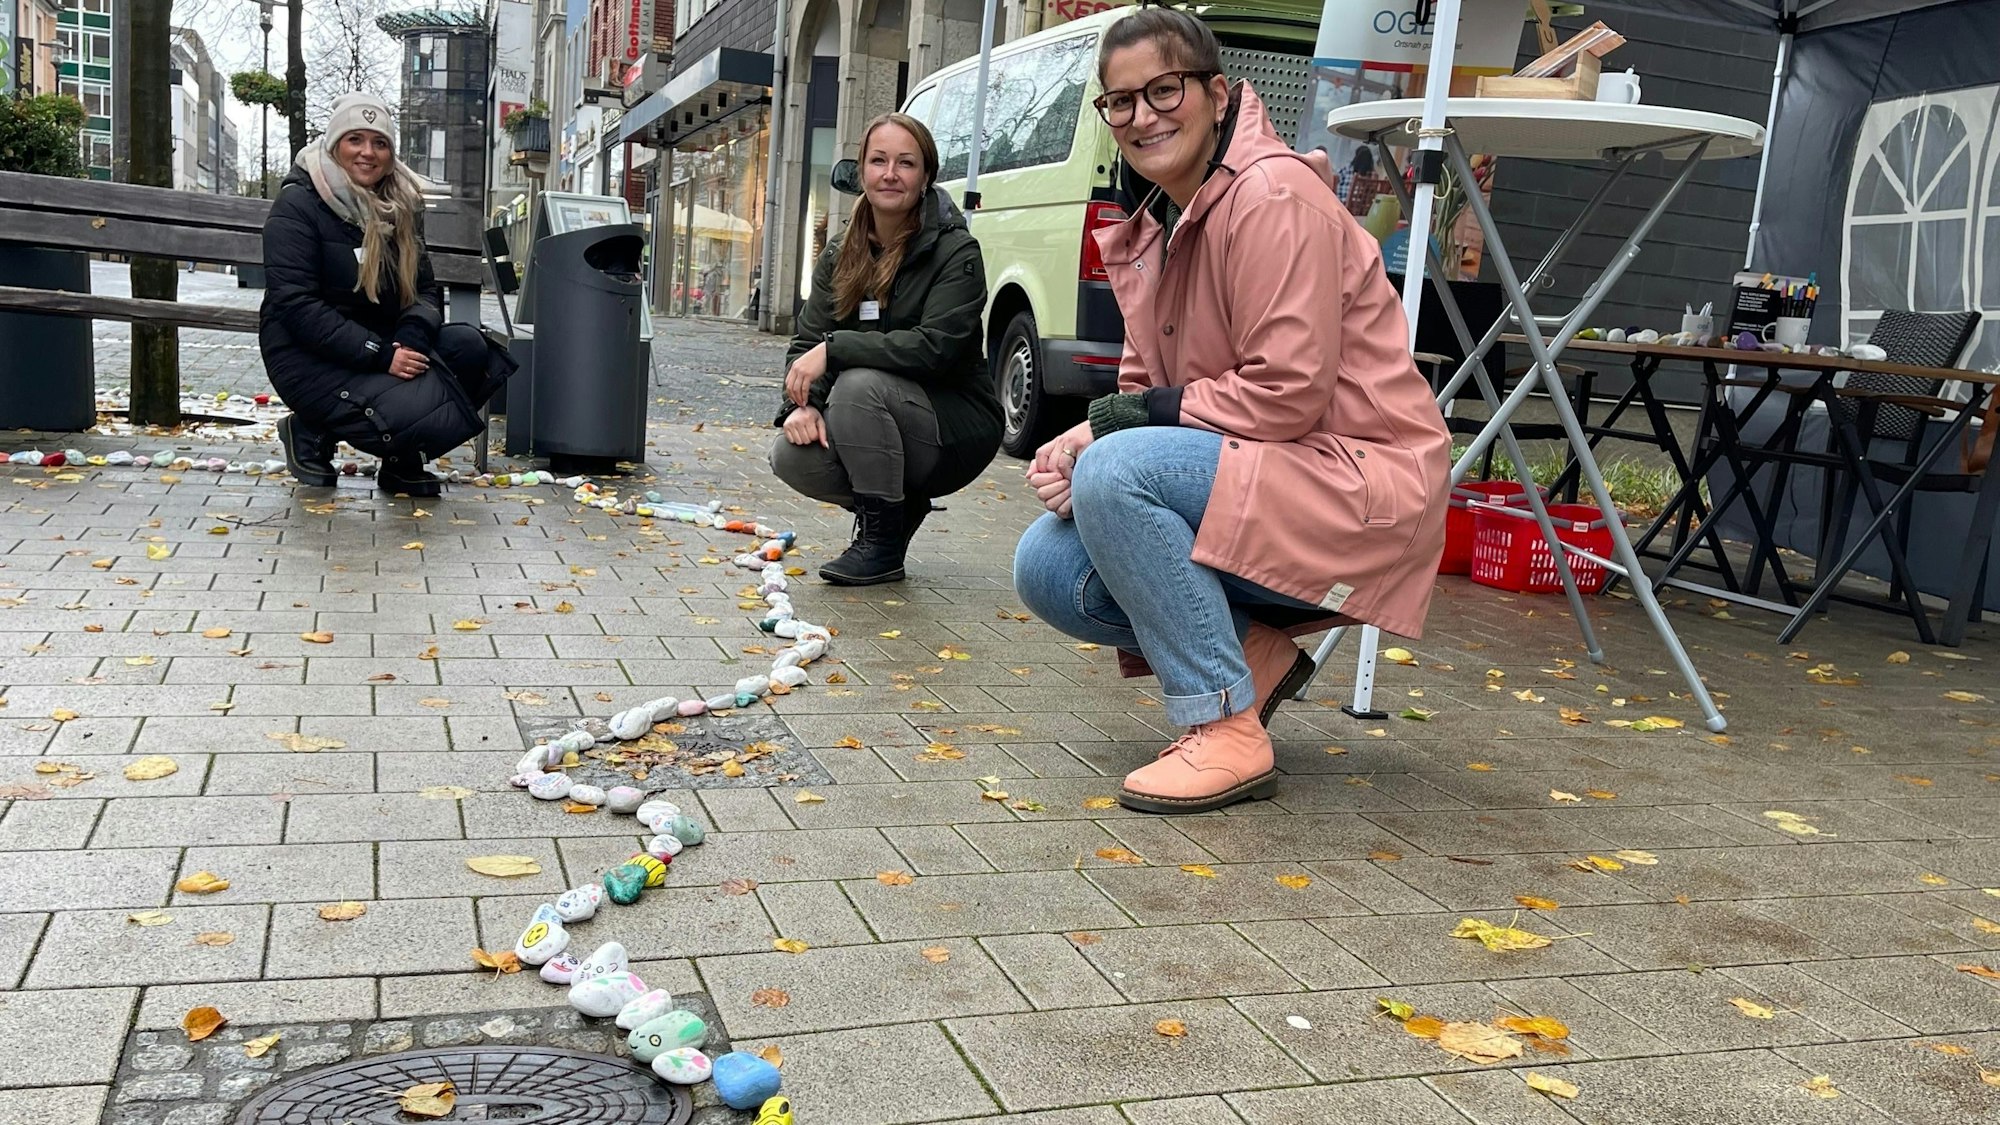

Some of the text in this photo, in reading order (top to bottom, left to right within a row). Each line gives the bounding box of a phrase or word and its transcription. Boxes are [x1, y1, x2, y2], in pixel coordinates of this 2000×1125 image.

[1373, 10, 1463, 35] OGE
[1394, 40, 1421, 49] Ortsnah
[501, 69, 527, 80] HAUS
